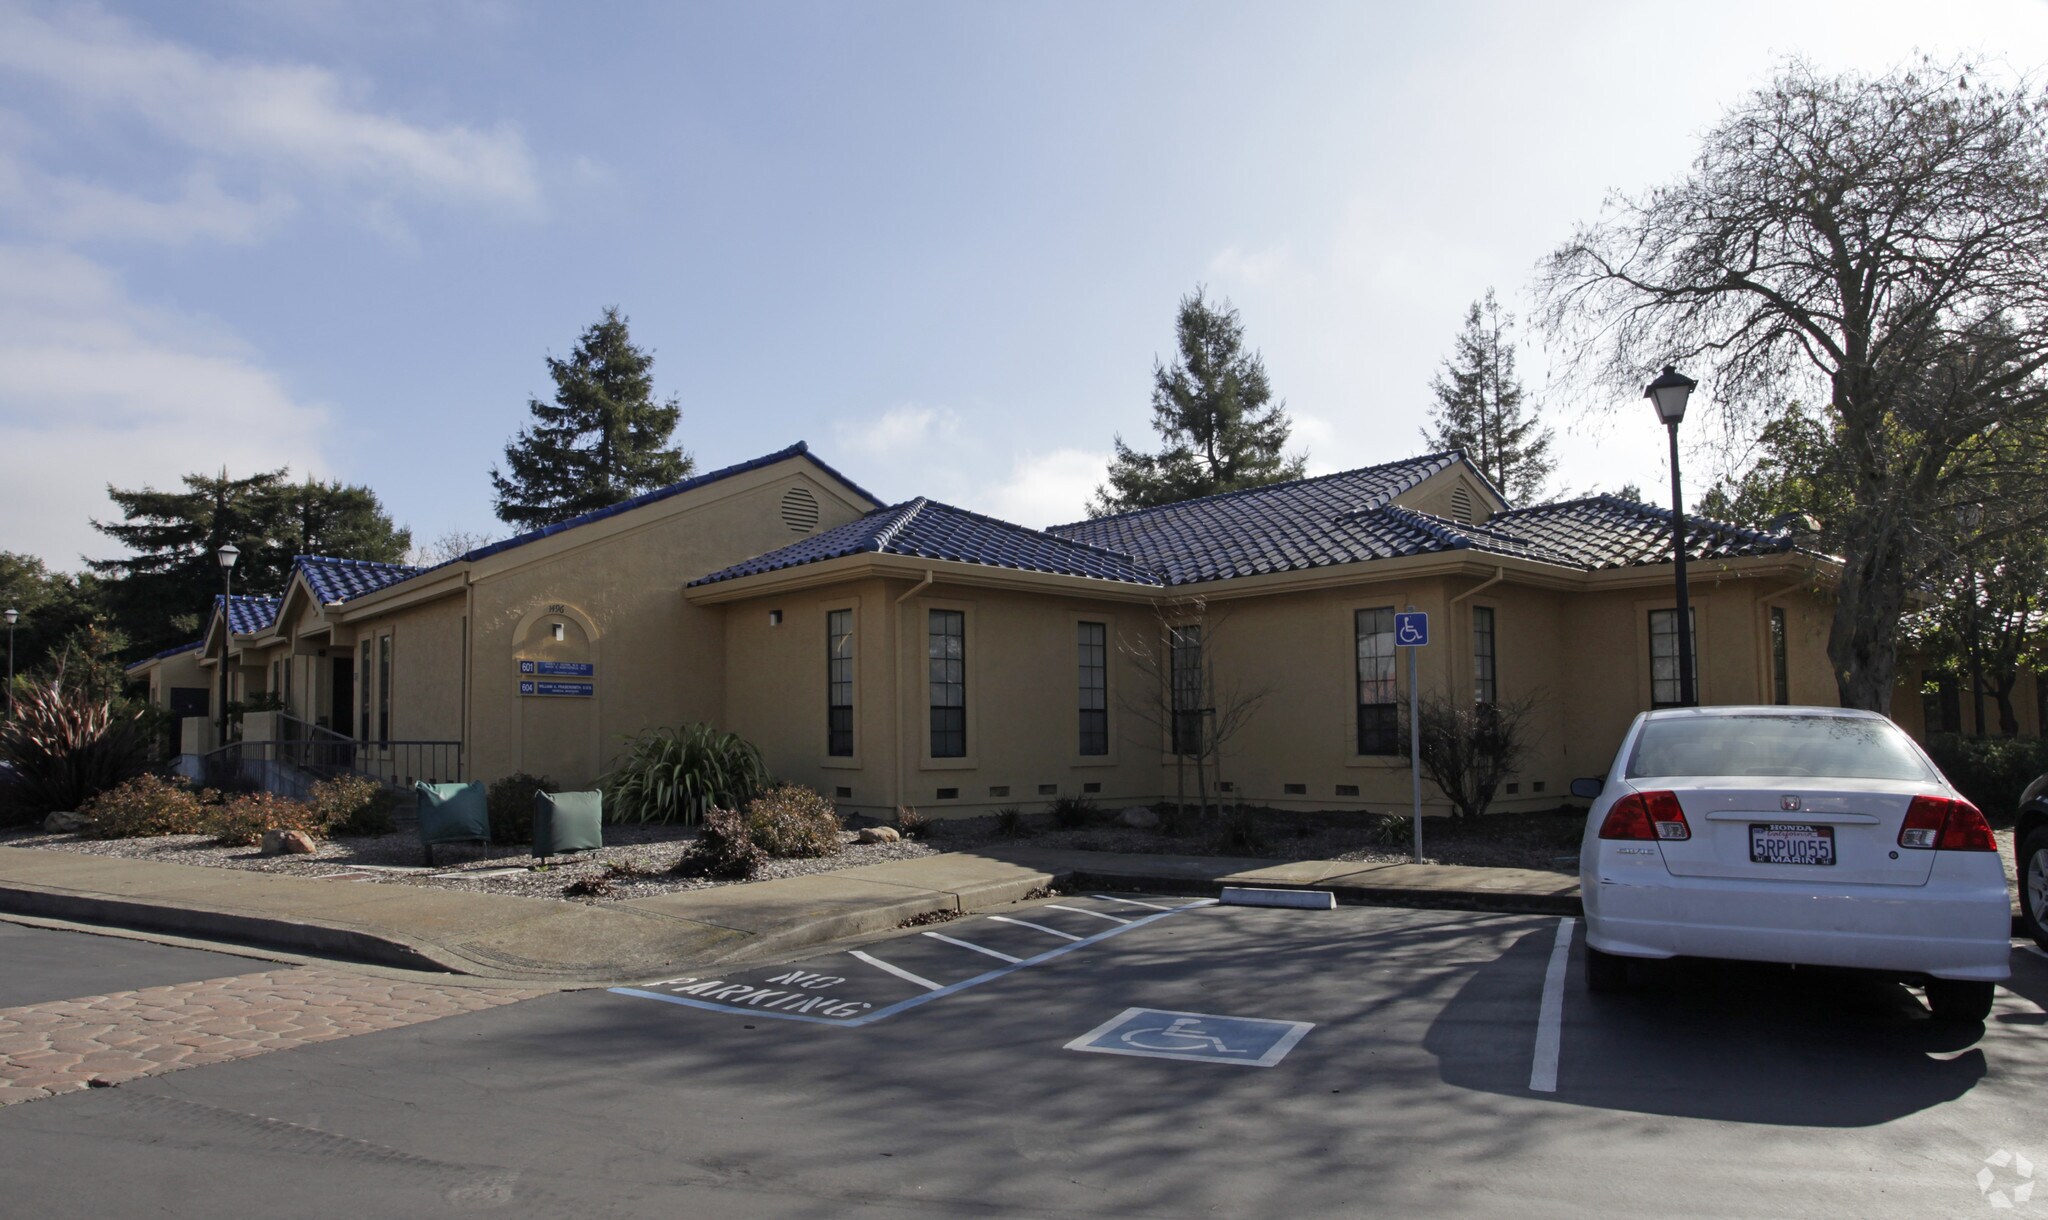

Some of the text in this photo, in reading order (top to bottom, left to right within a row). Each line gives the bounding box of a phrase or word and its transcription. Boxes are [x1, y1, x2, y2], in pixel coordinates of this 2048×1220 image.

[522, 663, 533, 672] 601
[521, 684, 533, 692] 604
[1756, 839, 1829, 859] 5RPU055
[1770, 856, 1816, 864] MARIN
[765, 970, 846, 989] NO
[642, 977, 871, 1018] PARKING
